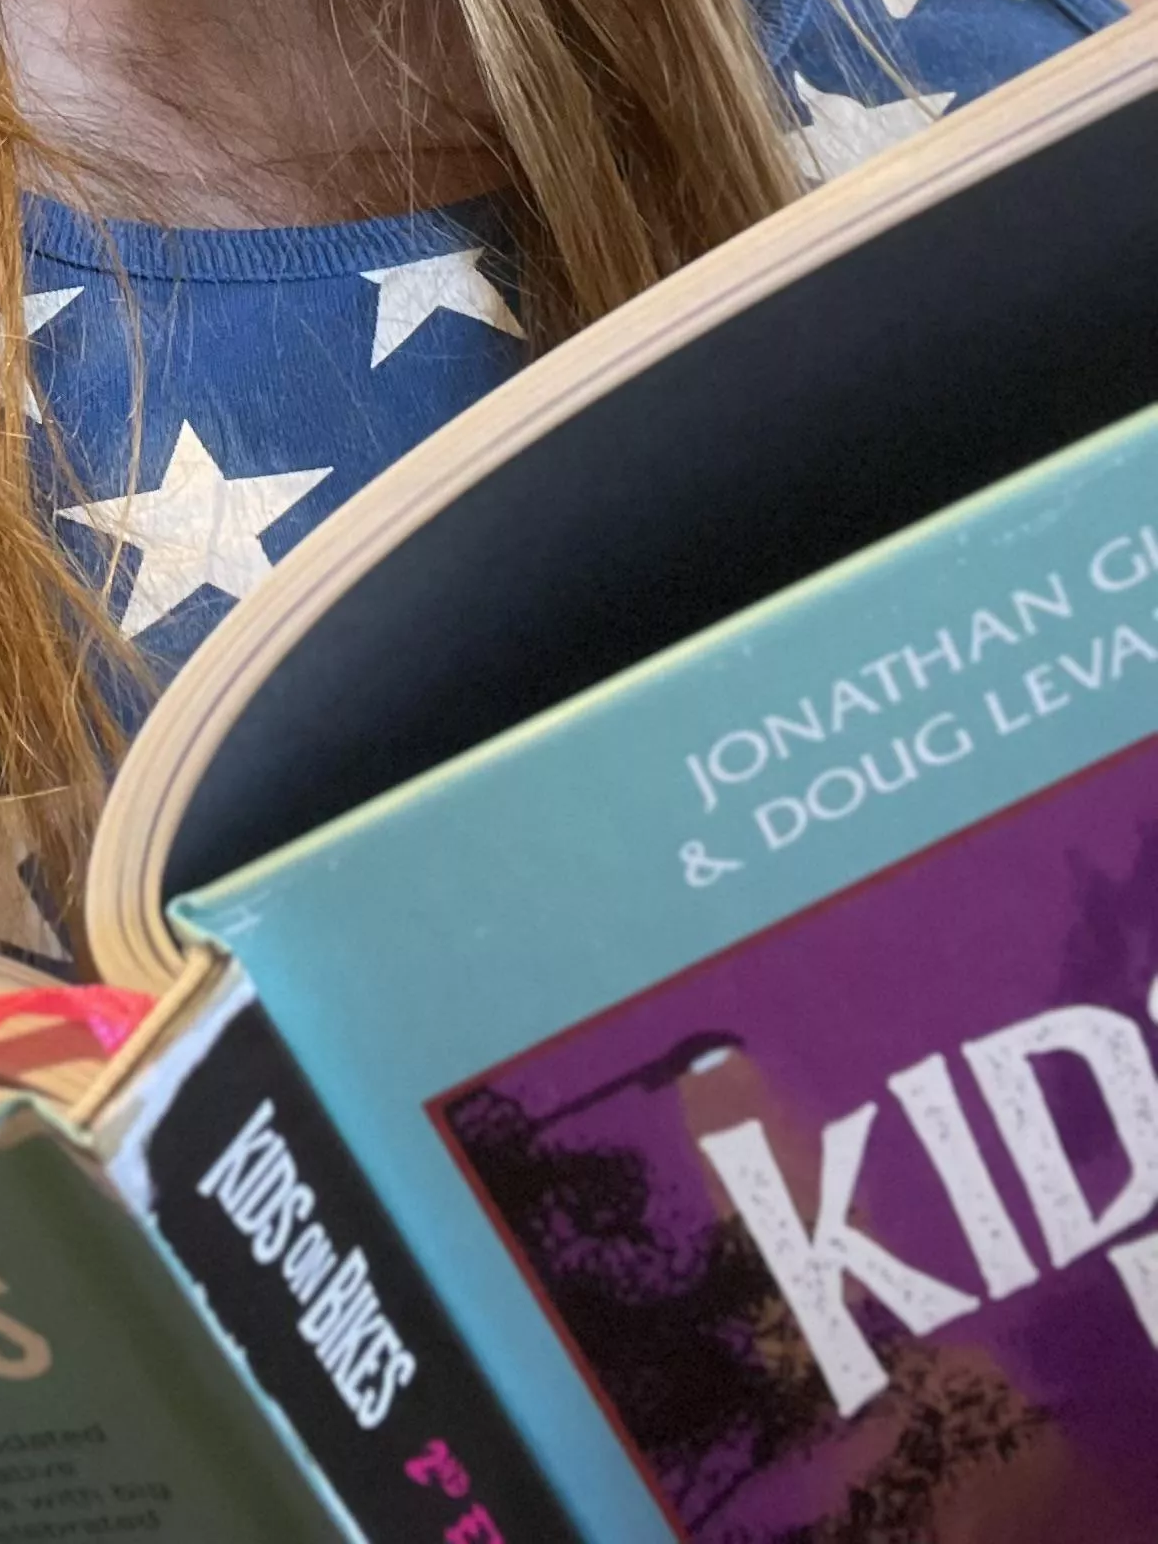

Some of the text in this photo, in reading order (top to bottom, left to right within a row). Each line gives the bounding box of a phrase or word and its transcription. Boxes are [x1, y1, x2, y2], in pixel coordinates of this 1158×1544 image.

[679, 608, 1158, 887] & DOUG LEVA
[686, 572, 1073, 813] JONATHAN
[196, 1097, 417, 1430] KIDS ON BIKES
[699, 971, 1158, 1418] KID
